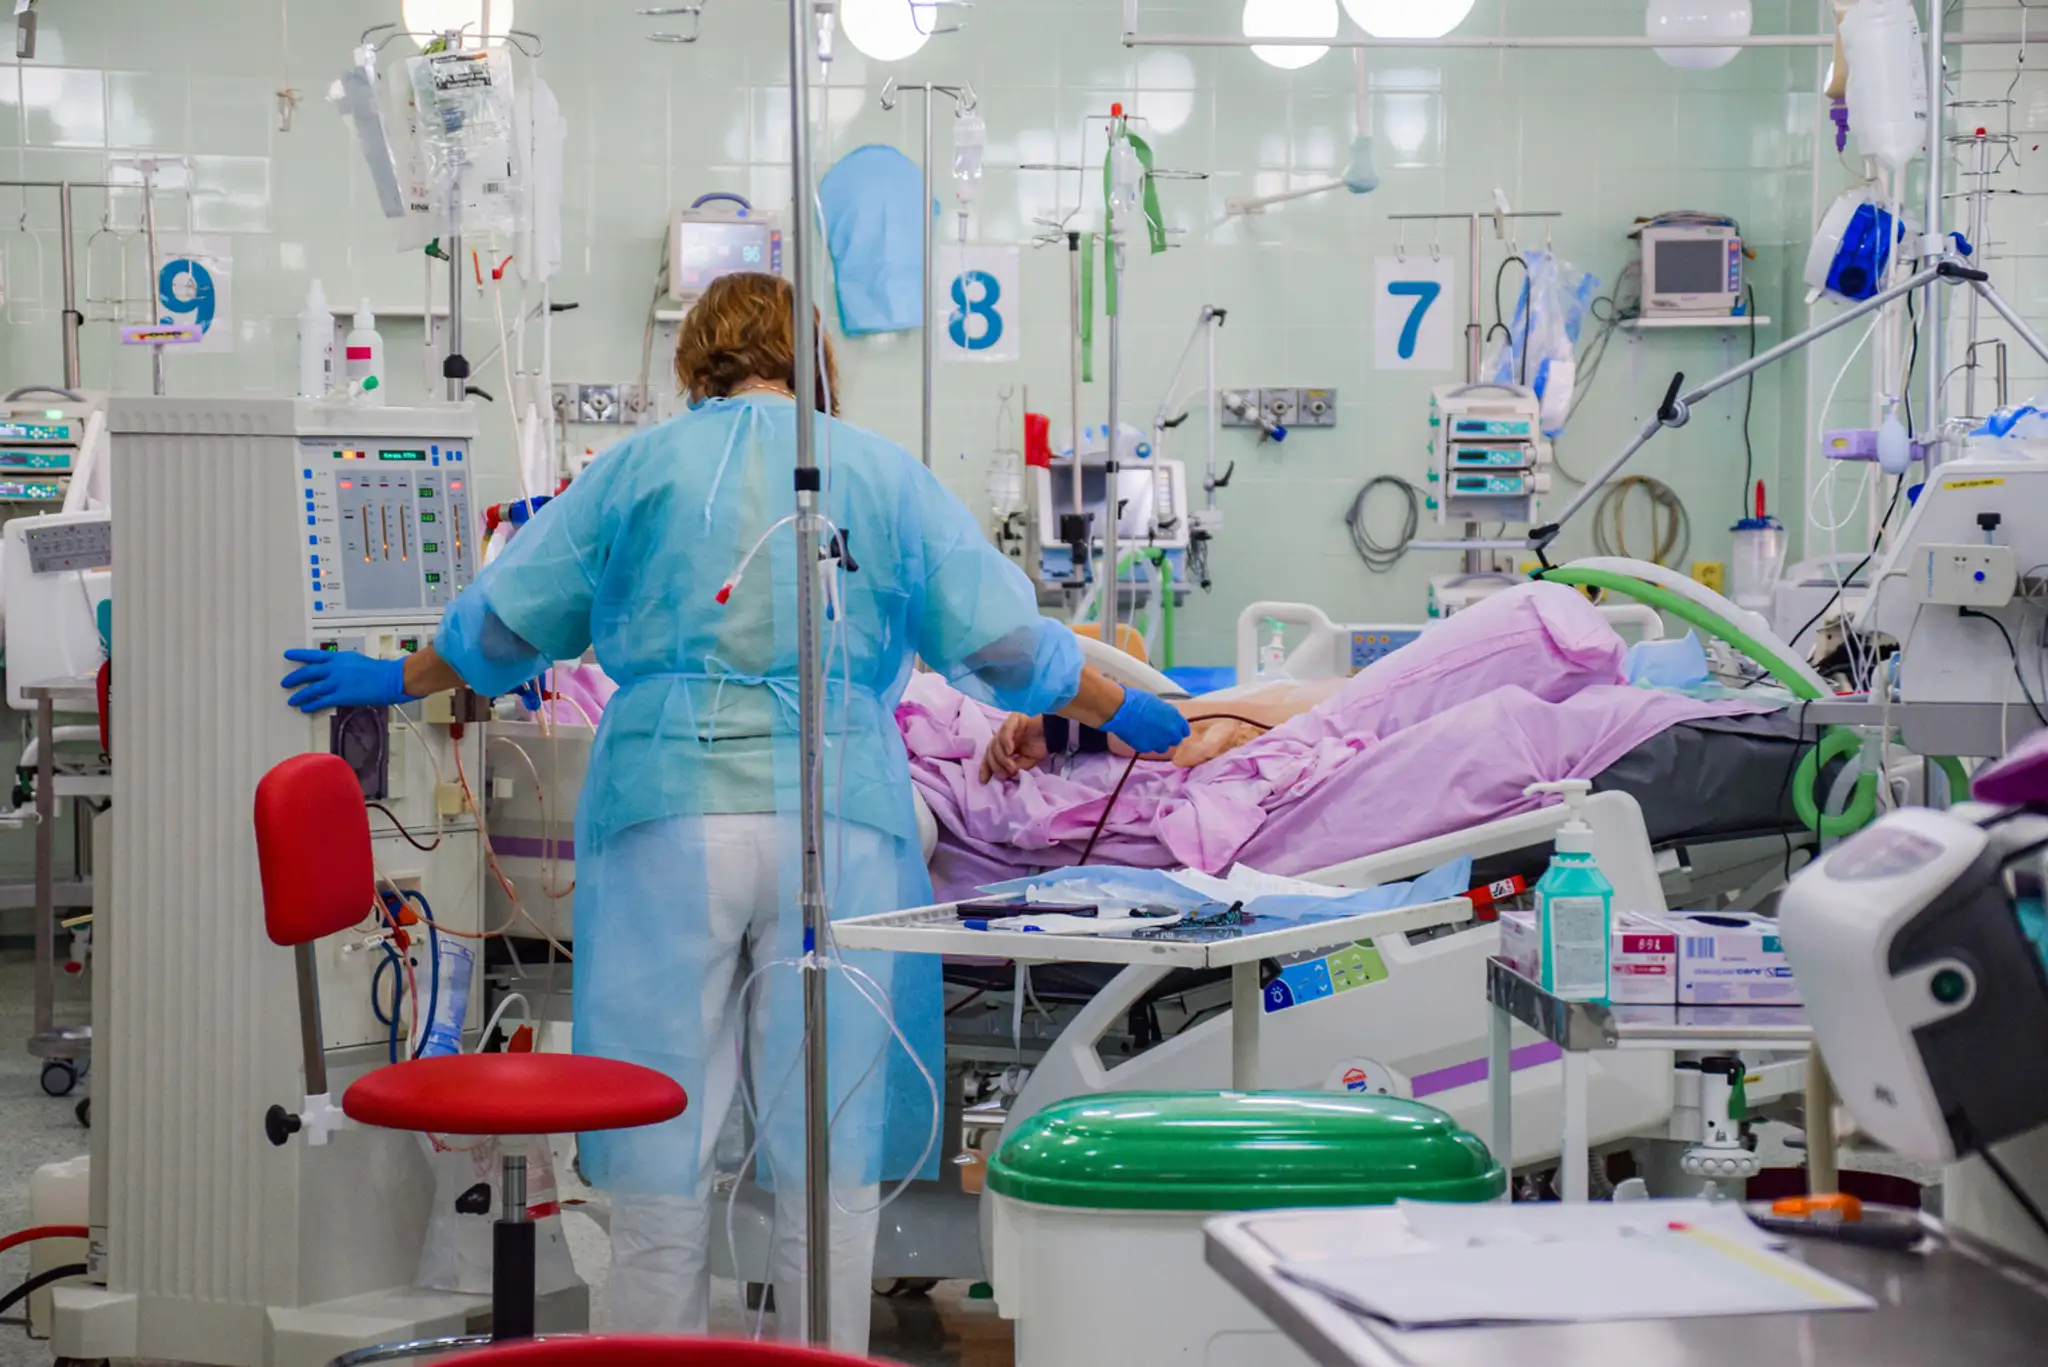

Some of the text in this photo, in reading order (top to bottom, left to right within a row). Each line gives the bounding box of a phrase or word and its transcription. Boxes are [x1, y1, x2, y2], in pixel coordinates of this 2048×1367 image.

[159, 258, 216, 336] 9
[948, 271, 1004, 351] 8
[1387, 281, 1442, 360] 7
